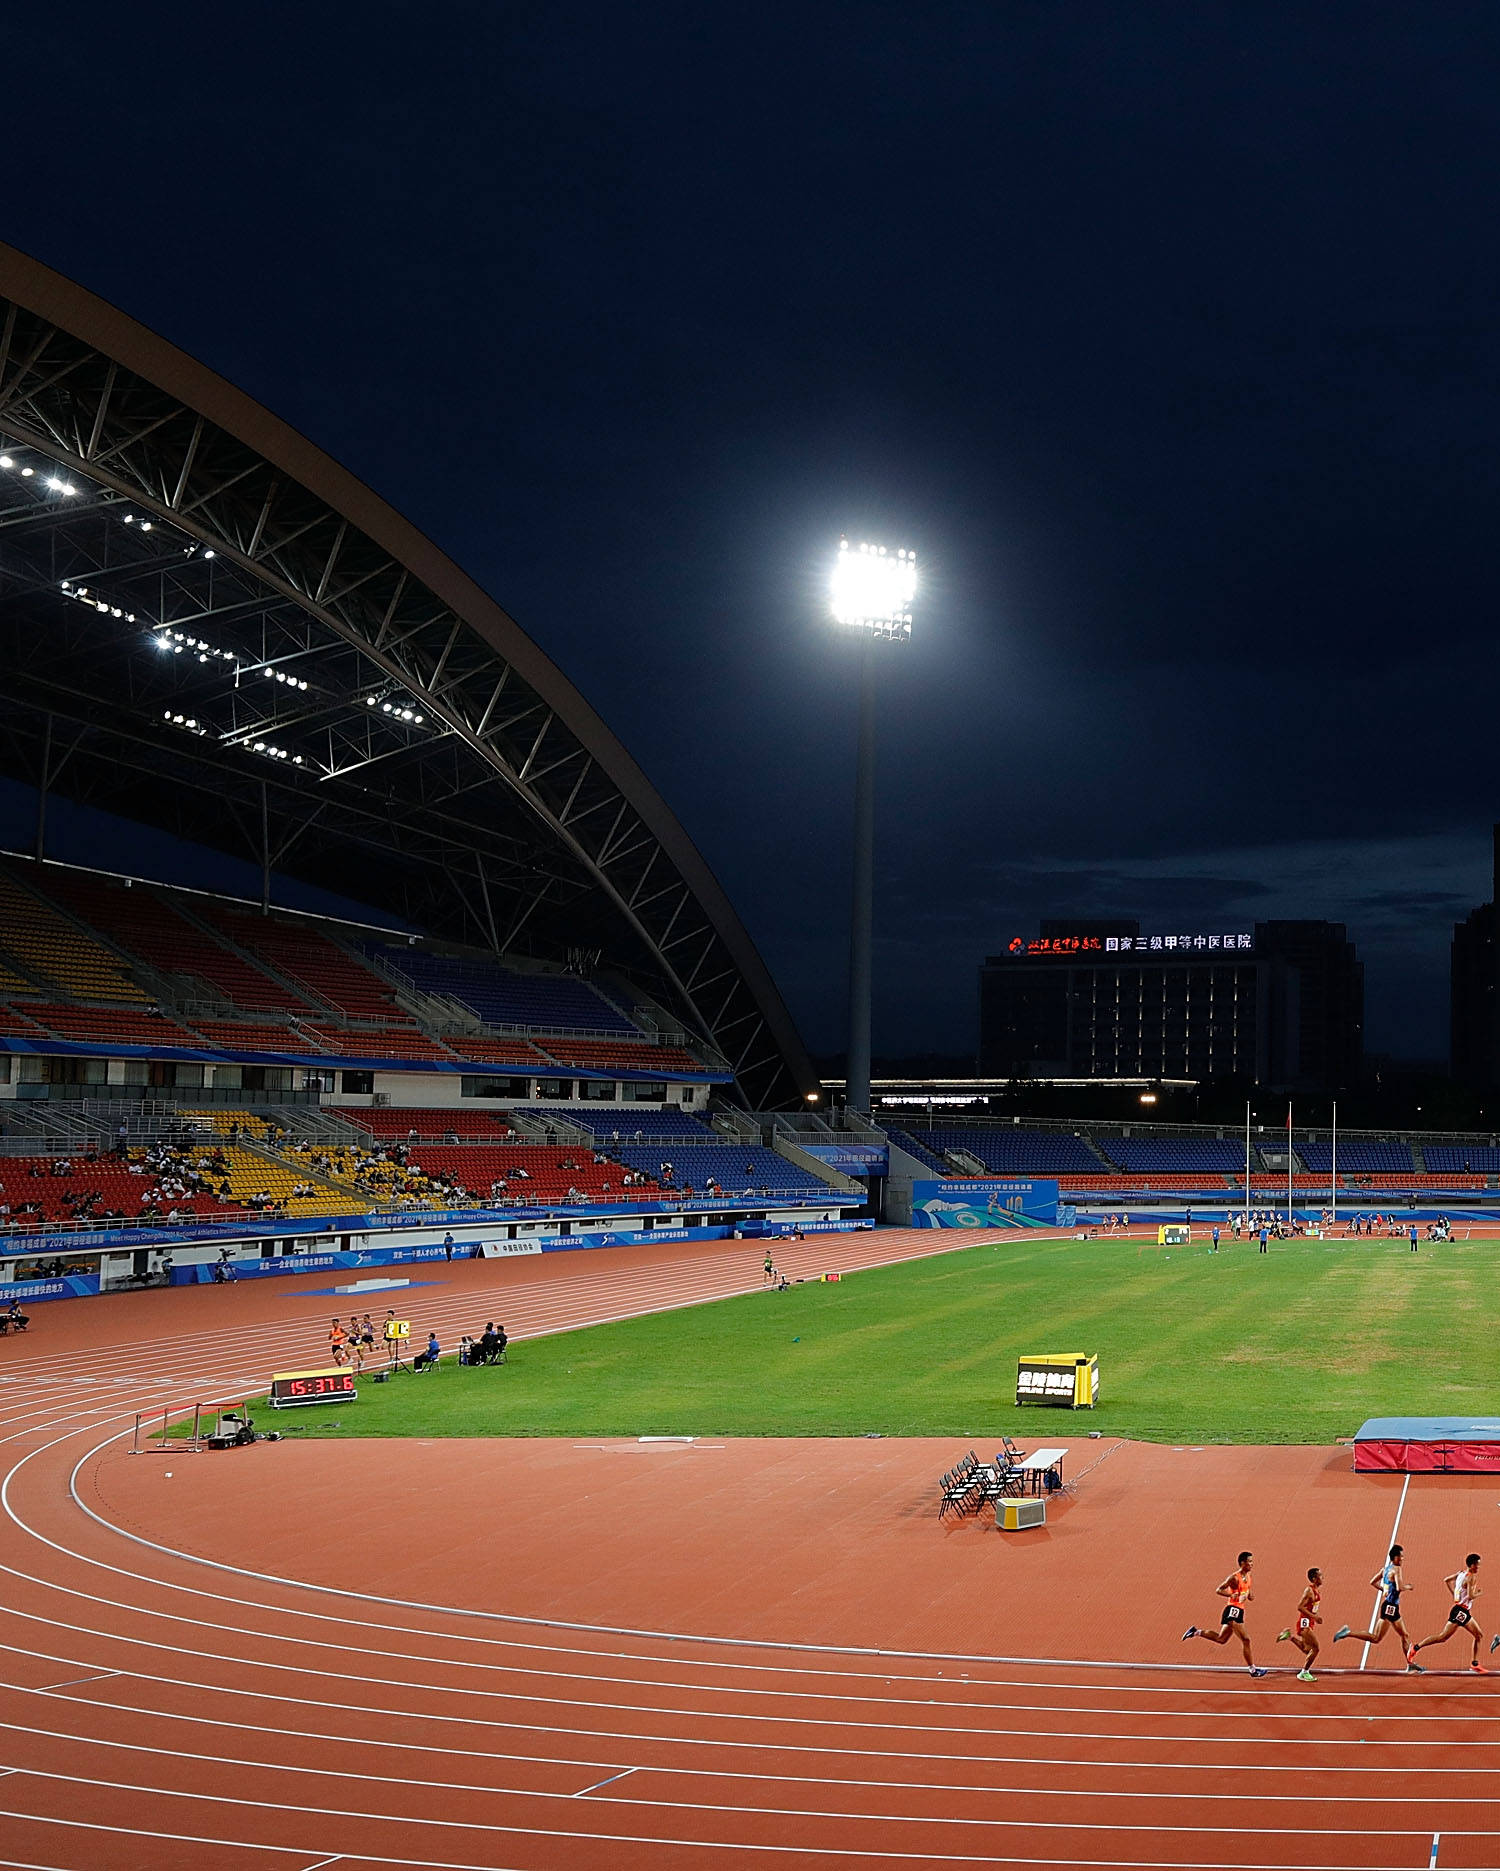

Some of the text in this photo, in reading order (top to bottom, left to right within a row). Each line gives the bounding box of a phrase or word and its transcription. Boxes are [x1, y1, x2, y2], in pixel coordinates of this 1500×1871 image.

[1105, 933, 1251, 951] 国家三级甲等中医医院
[502, 1244, 534, 1252] 中国田径协会
[290, 1376, 354, 1395] 15:37.6
[1018, 1372, 1075, 1388] 金陵体育
